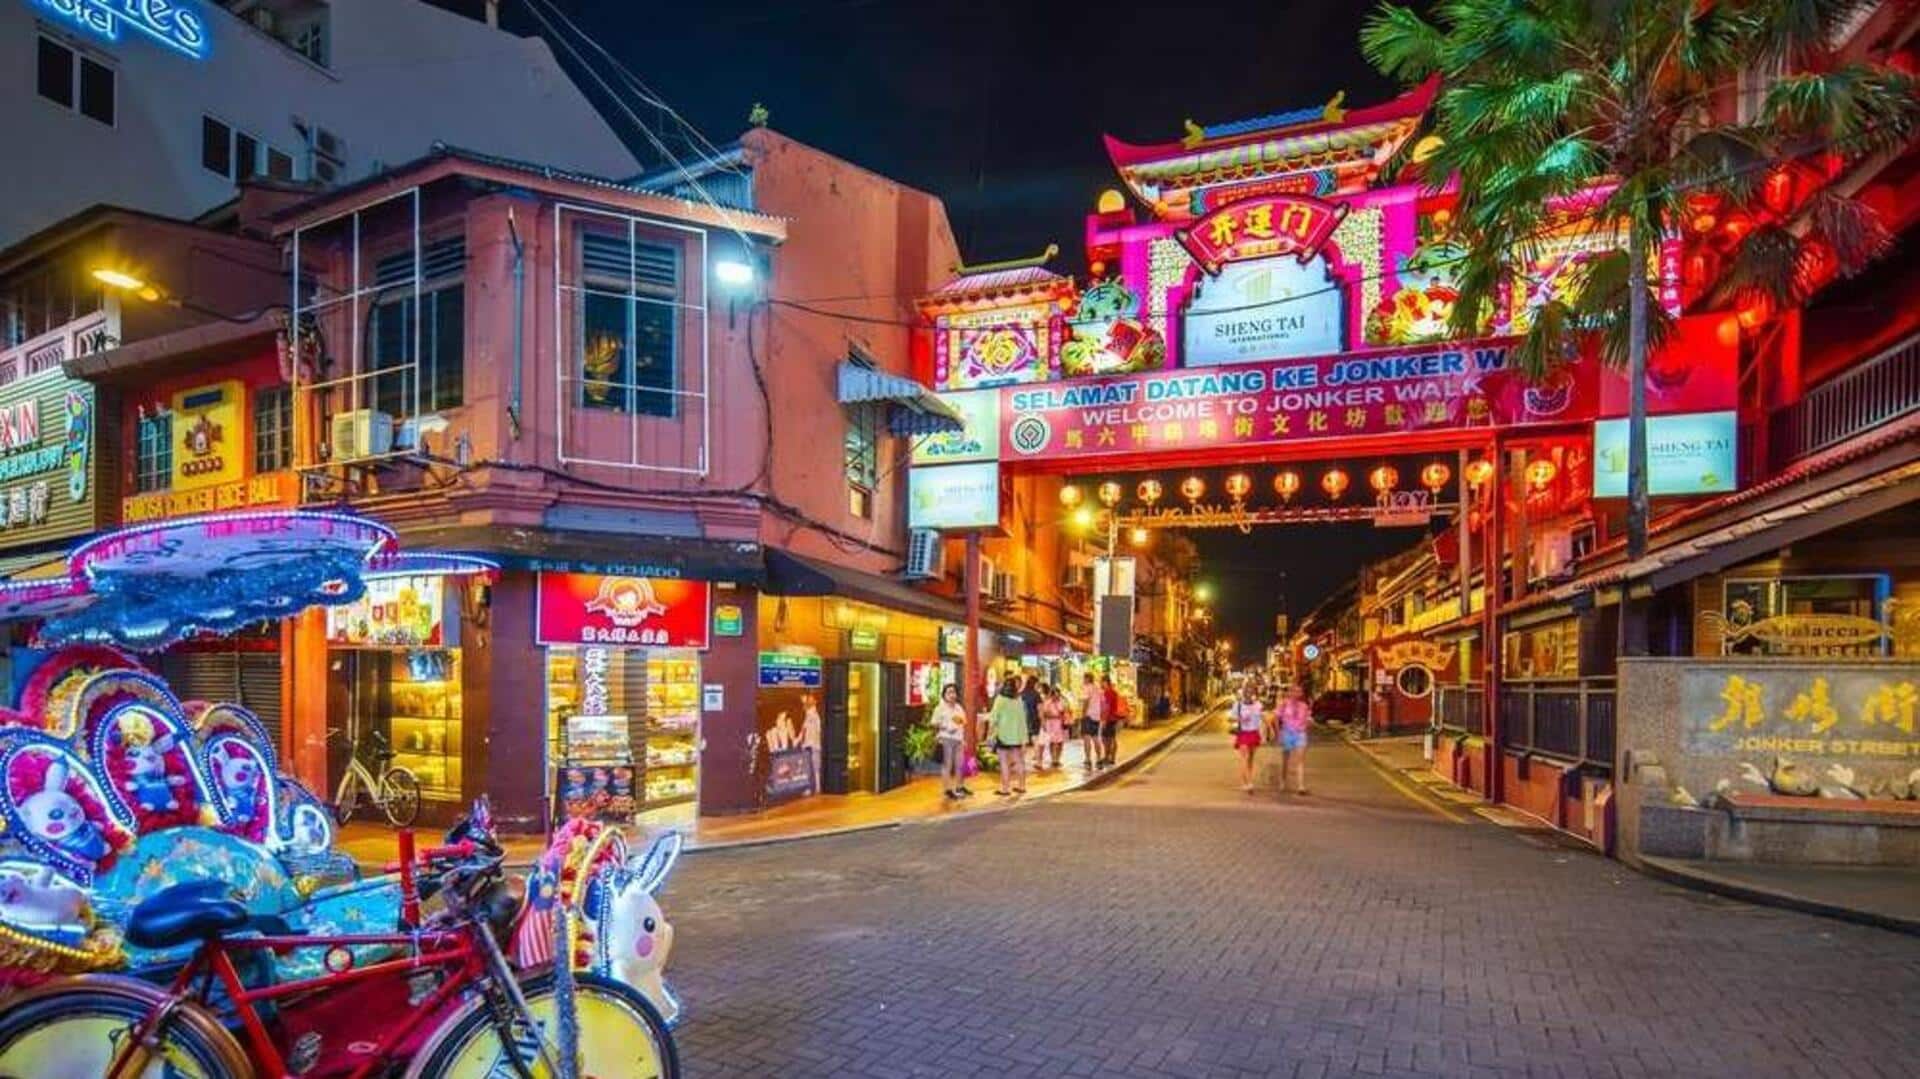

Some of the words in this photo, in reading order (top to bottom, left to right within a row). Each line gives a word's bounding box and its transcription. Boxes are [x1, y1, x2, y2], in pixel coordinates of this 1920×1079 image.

[42, 0, 118, 39] otel
[1214, 318, 1272, 337] SHENG
[1276, 315, 1305, 331] TAI
[1013, 383, 1138, 412] SELAMAT
[1147, 371, 1265, 400] DATANG
[1274, 364, 1318, 390] KE
[1325, 351, 1465, 385] JONKER
[1082, 399, 1212, 426] WELCOME
[1225, 396, 1258, 416] TO
[1266, 386, 1384, 413] JONKER
[1394, 376, 1485, 402] WALK
[1651, 440, 1701, 454] SHENG
[1704, 438, 1729, 451] TAI
[1732, 735, 1823, 752] JONKER
[1832, 739, 1920, 755] STREET
